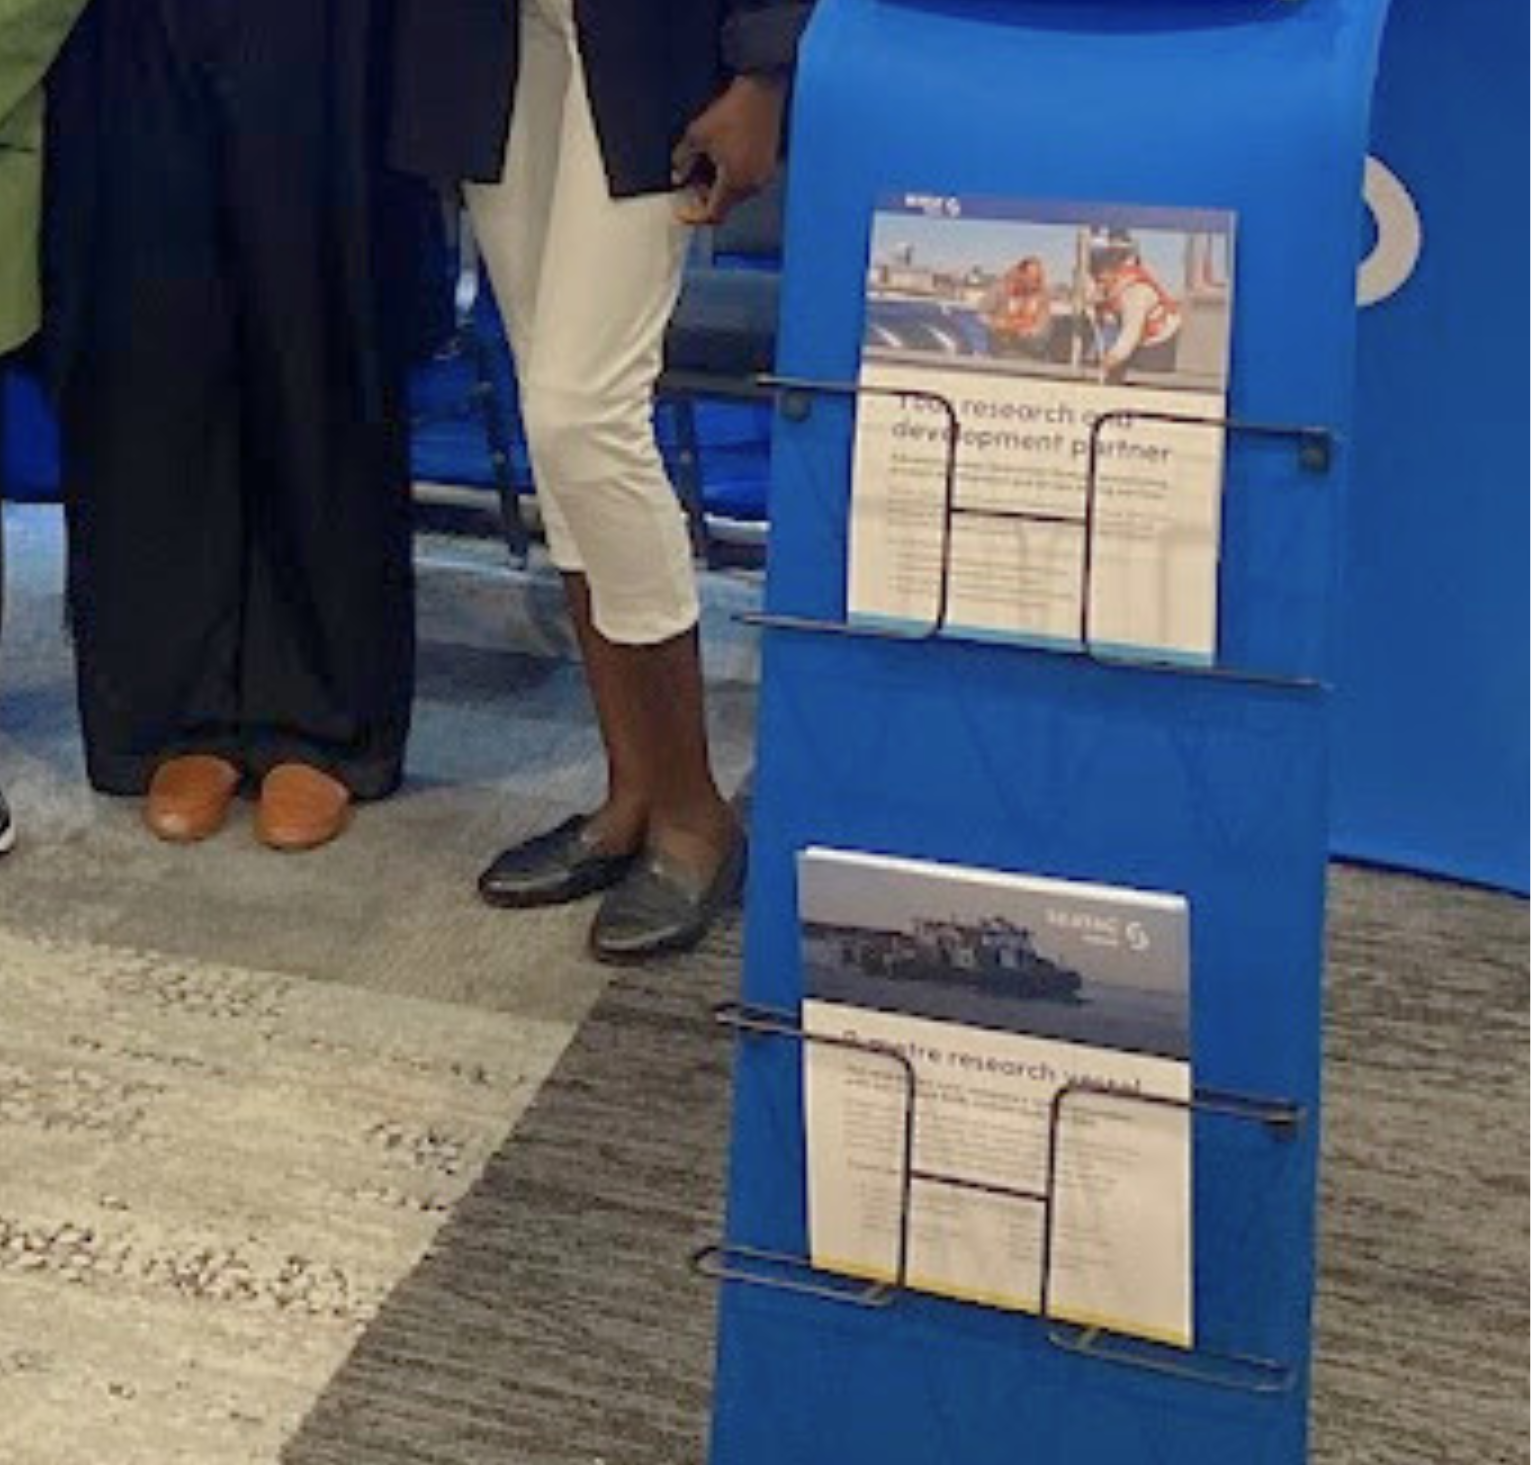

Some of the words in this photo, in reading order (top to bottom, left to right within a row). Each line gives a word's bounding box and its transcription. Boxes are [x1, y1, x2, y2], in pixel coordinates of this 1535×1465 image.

[964, 398, 1074, 426] research
[891, 417, 1066, 451] deveopment
[948, 1050, 1056, 1083] research
